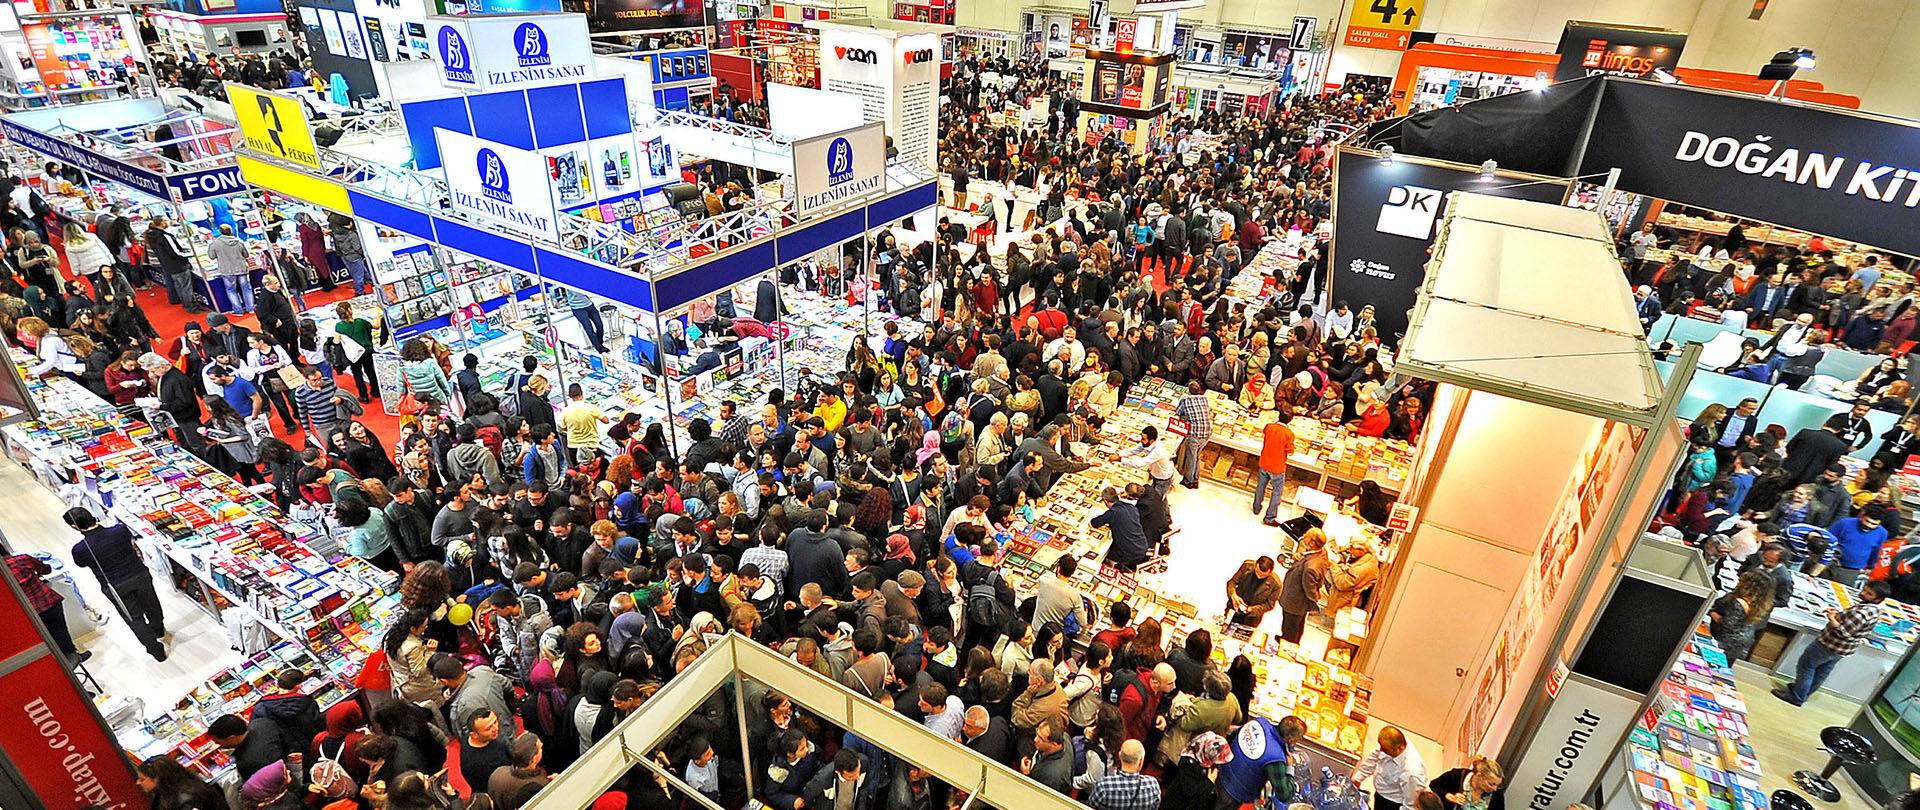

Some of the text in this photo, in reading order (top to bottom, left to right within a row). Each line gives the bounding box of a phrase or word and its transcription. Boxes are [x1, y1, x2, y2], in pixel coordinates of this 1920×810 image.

[1370, 0, 1398, 23] 4
[518, 55, 550, 66] İZLENİM
[846, 47, 877, 64] can
[913, 48, 933, 64] can
[1602, 51, 1655, 77] timaş
[488, 64, 586, 85] İZLENİM SANAT
[247, 136, 317, 166] HAYAL PEREST
[1675, 131, 1846, 190] DOĞAN
[829, 172, 853, 186] İZLENİM
[482, 186, 512, 203] İZLENİM
[803, 175, 879, 211] İZLENİM SANAT
[455, 189, 549, 232] İZLENİM SANAT
